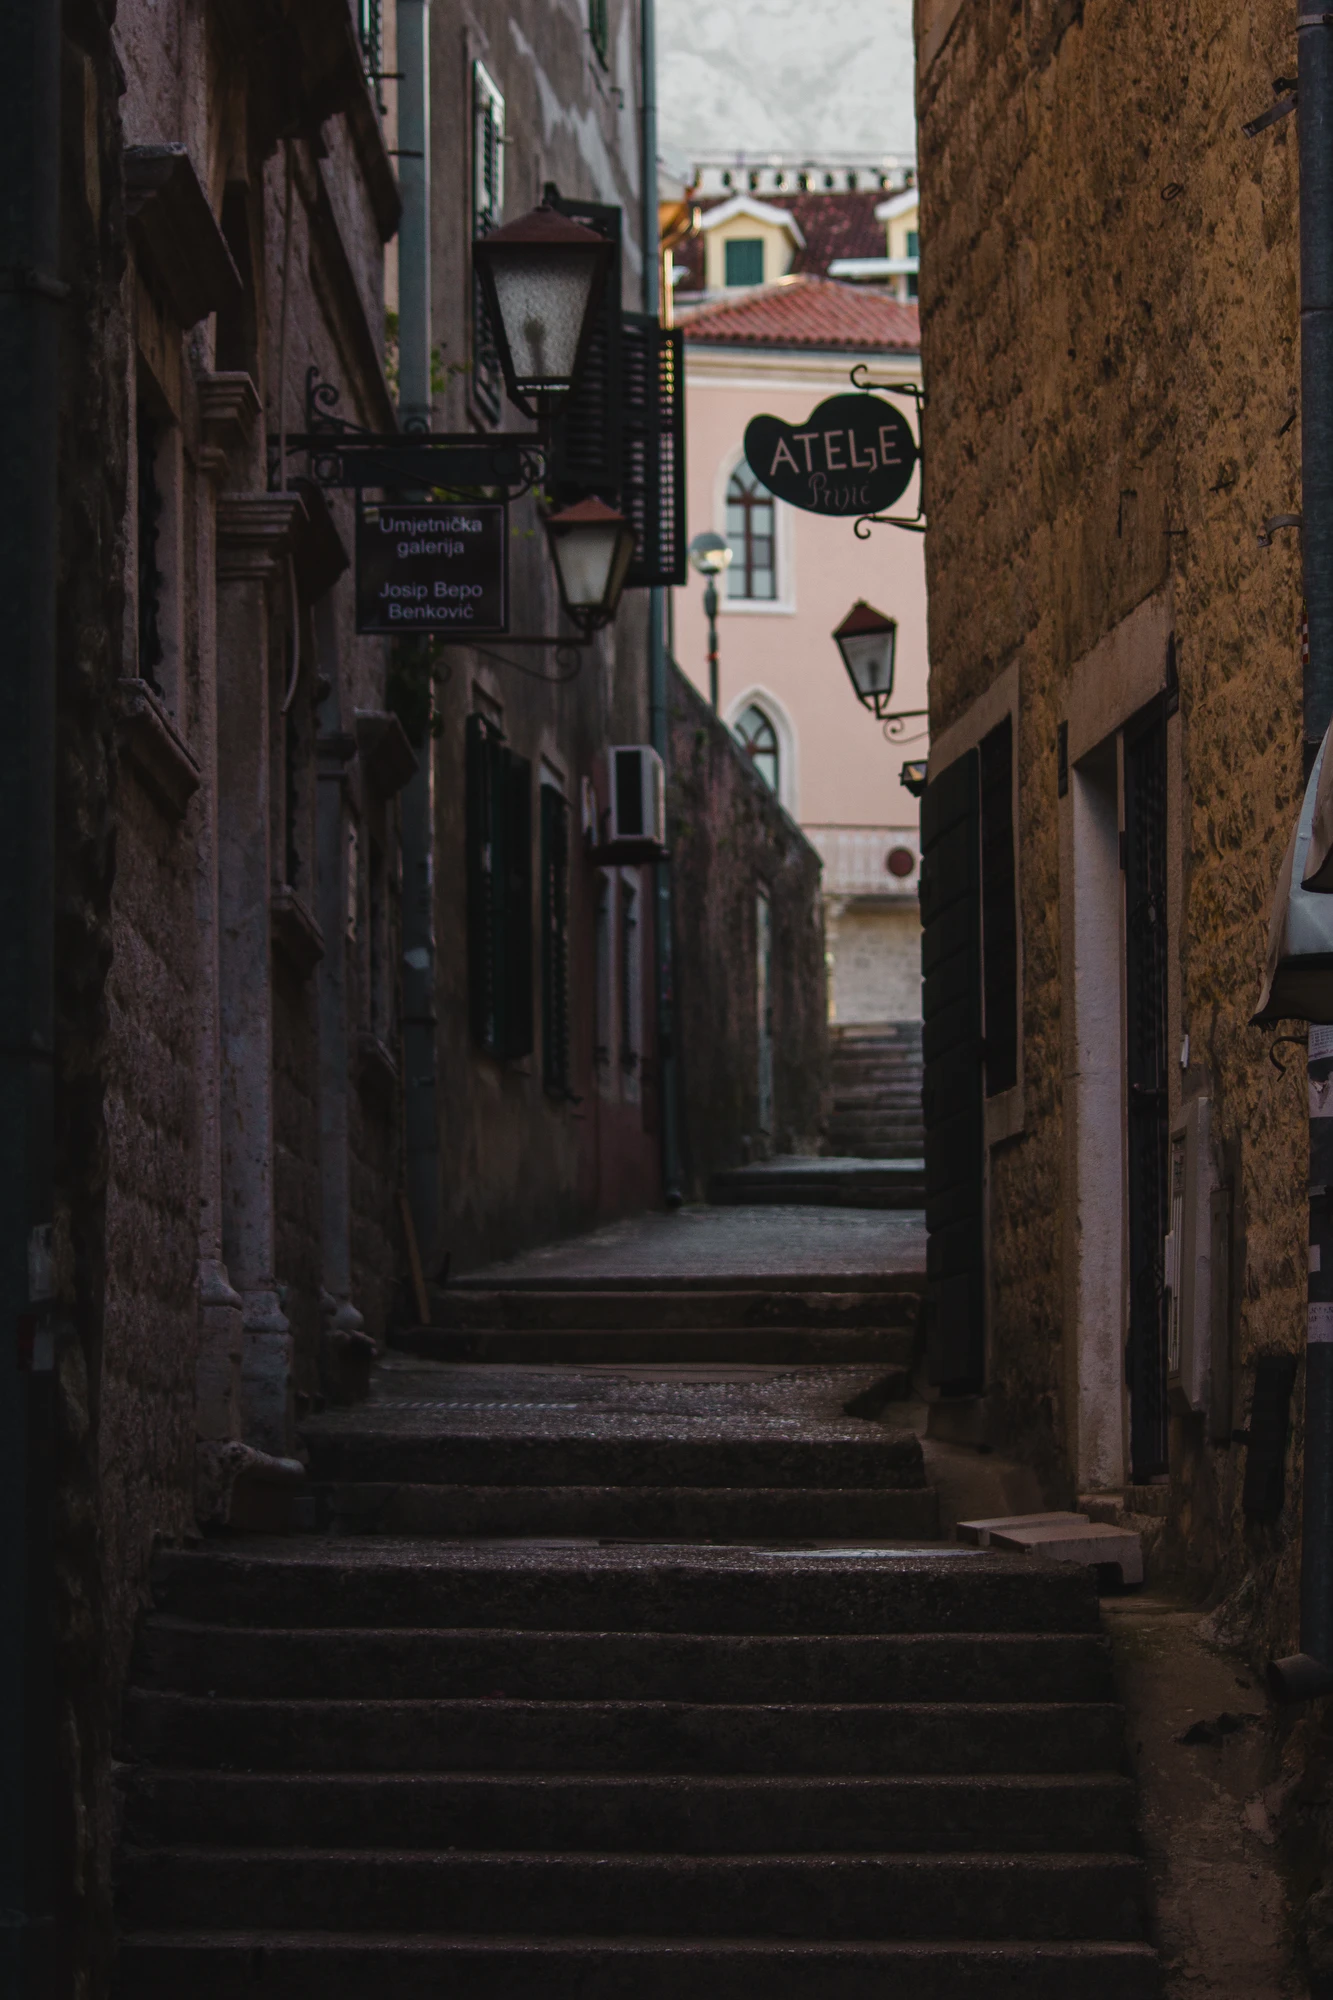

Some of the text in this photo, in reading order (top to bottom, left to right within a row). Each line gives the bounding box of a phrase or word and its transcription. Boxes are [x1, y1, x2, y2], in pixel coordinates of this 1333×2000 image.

[380, 516, 482, 536] Umjetnička
[397, 538, 465, 558] galerija
[379, 581, 483, 601] Josip Bepo
[388, 602, 474, 620] Benković
